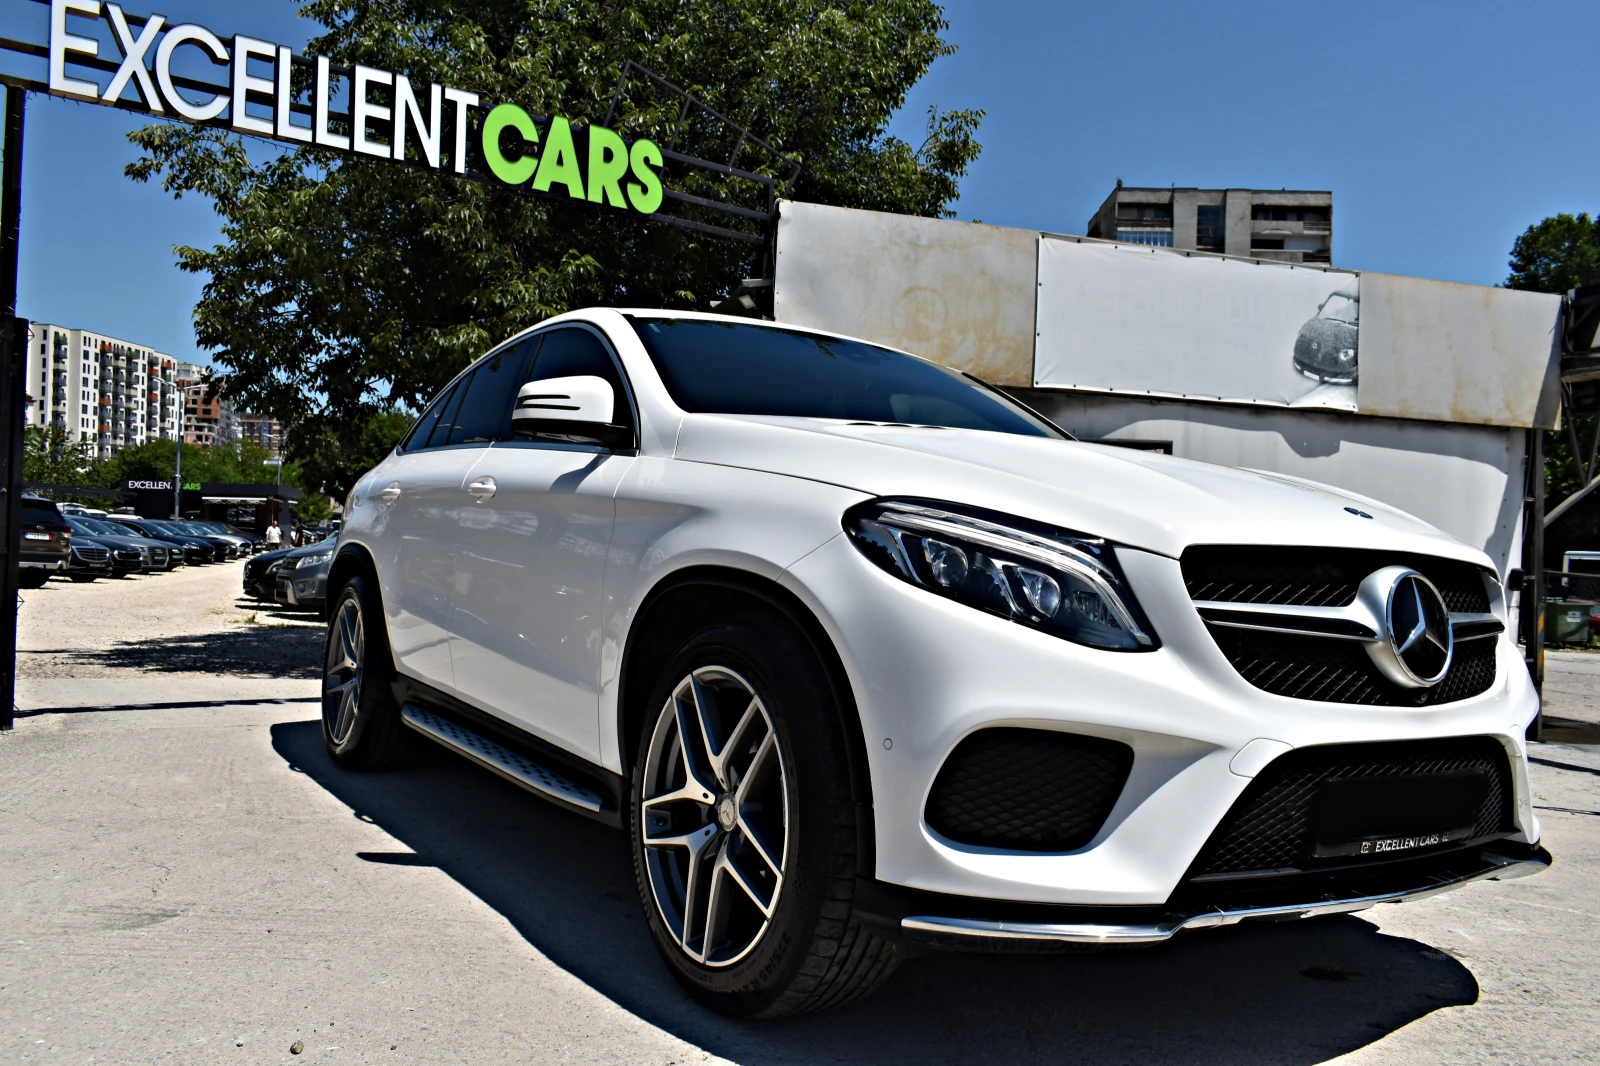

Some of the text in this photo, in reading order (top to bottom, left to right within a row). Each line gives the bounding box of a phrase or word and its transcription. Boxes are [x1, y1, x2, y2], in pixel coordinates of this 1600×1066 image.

[50, 0, 663, 214] EXCELLENT CARS
[128, 481, 173, 490] EXCELLEN
[1375, 834, 1439, 852] EXCELLENT CARS
